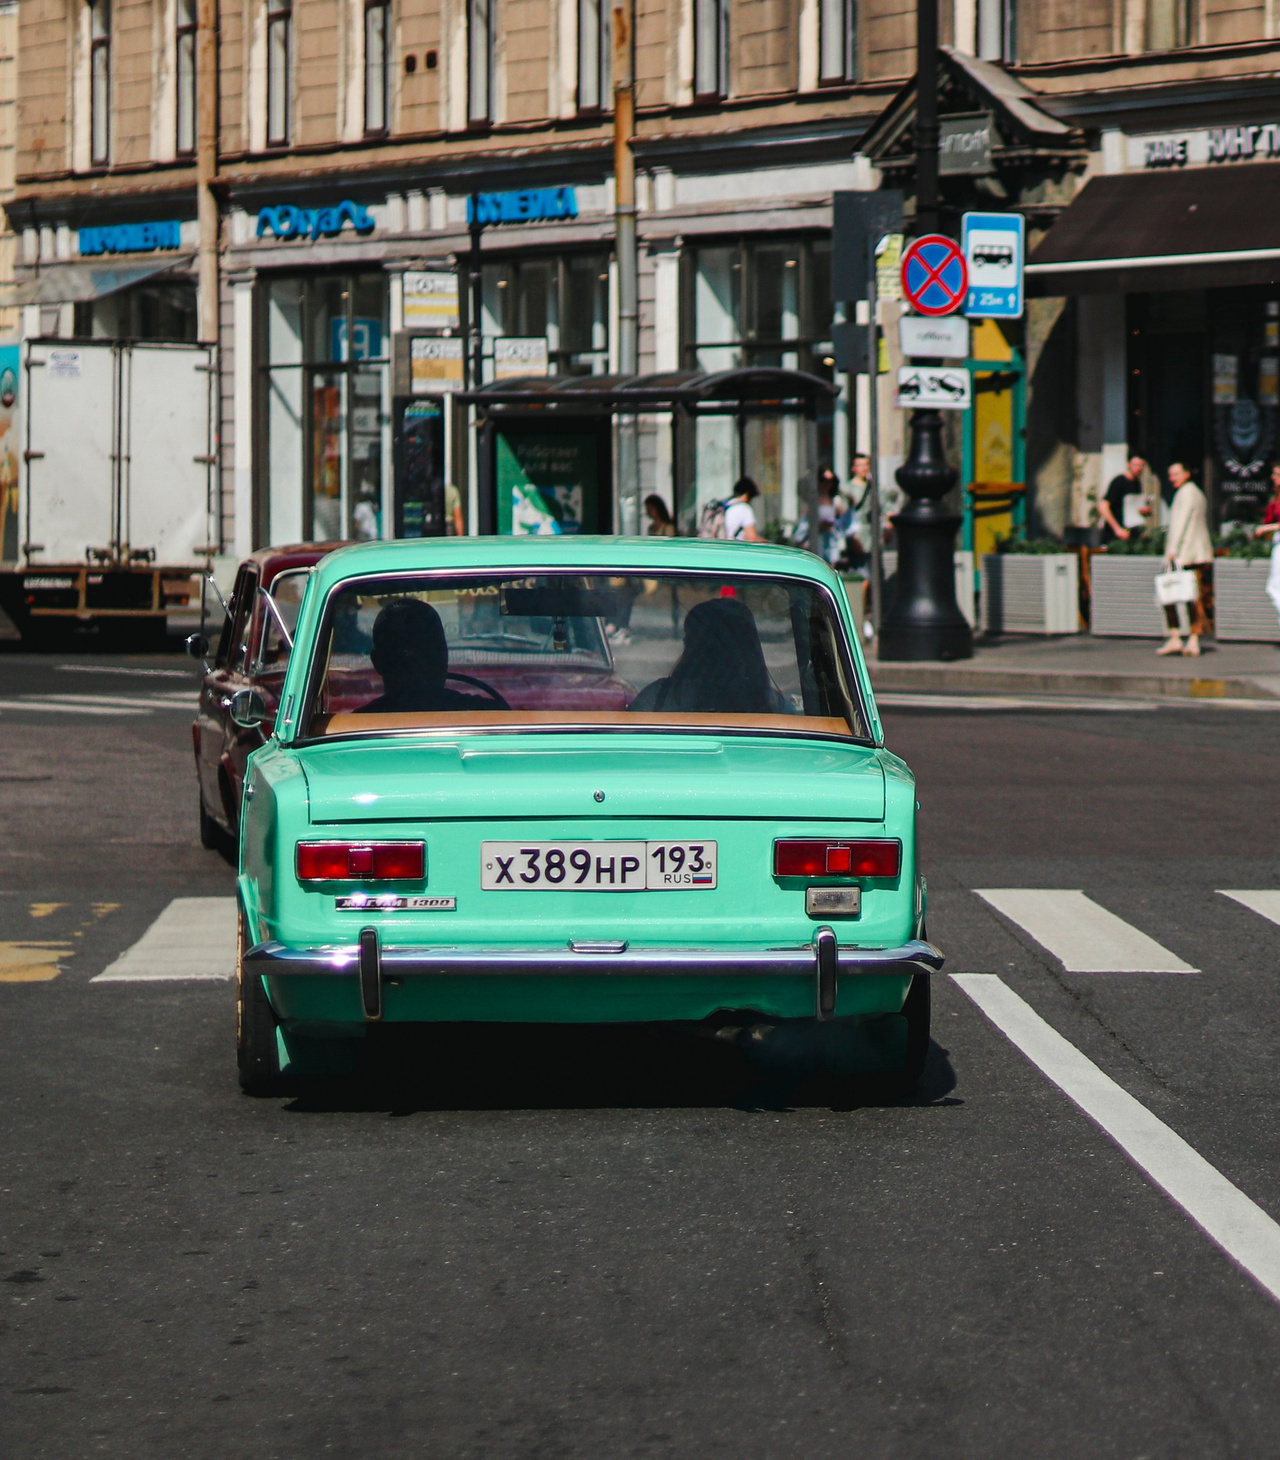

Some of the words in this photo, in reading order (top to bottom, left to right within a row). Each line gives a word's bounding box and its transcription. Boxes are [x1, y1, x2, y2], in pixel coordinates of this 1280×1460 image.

[1206, 125, 1260, 158] КИНГ
[651, 845, 705, 873] 193
[664, 873, 691, 884] RUS
[412, 899, 451, 907] 1300
